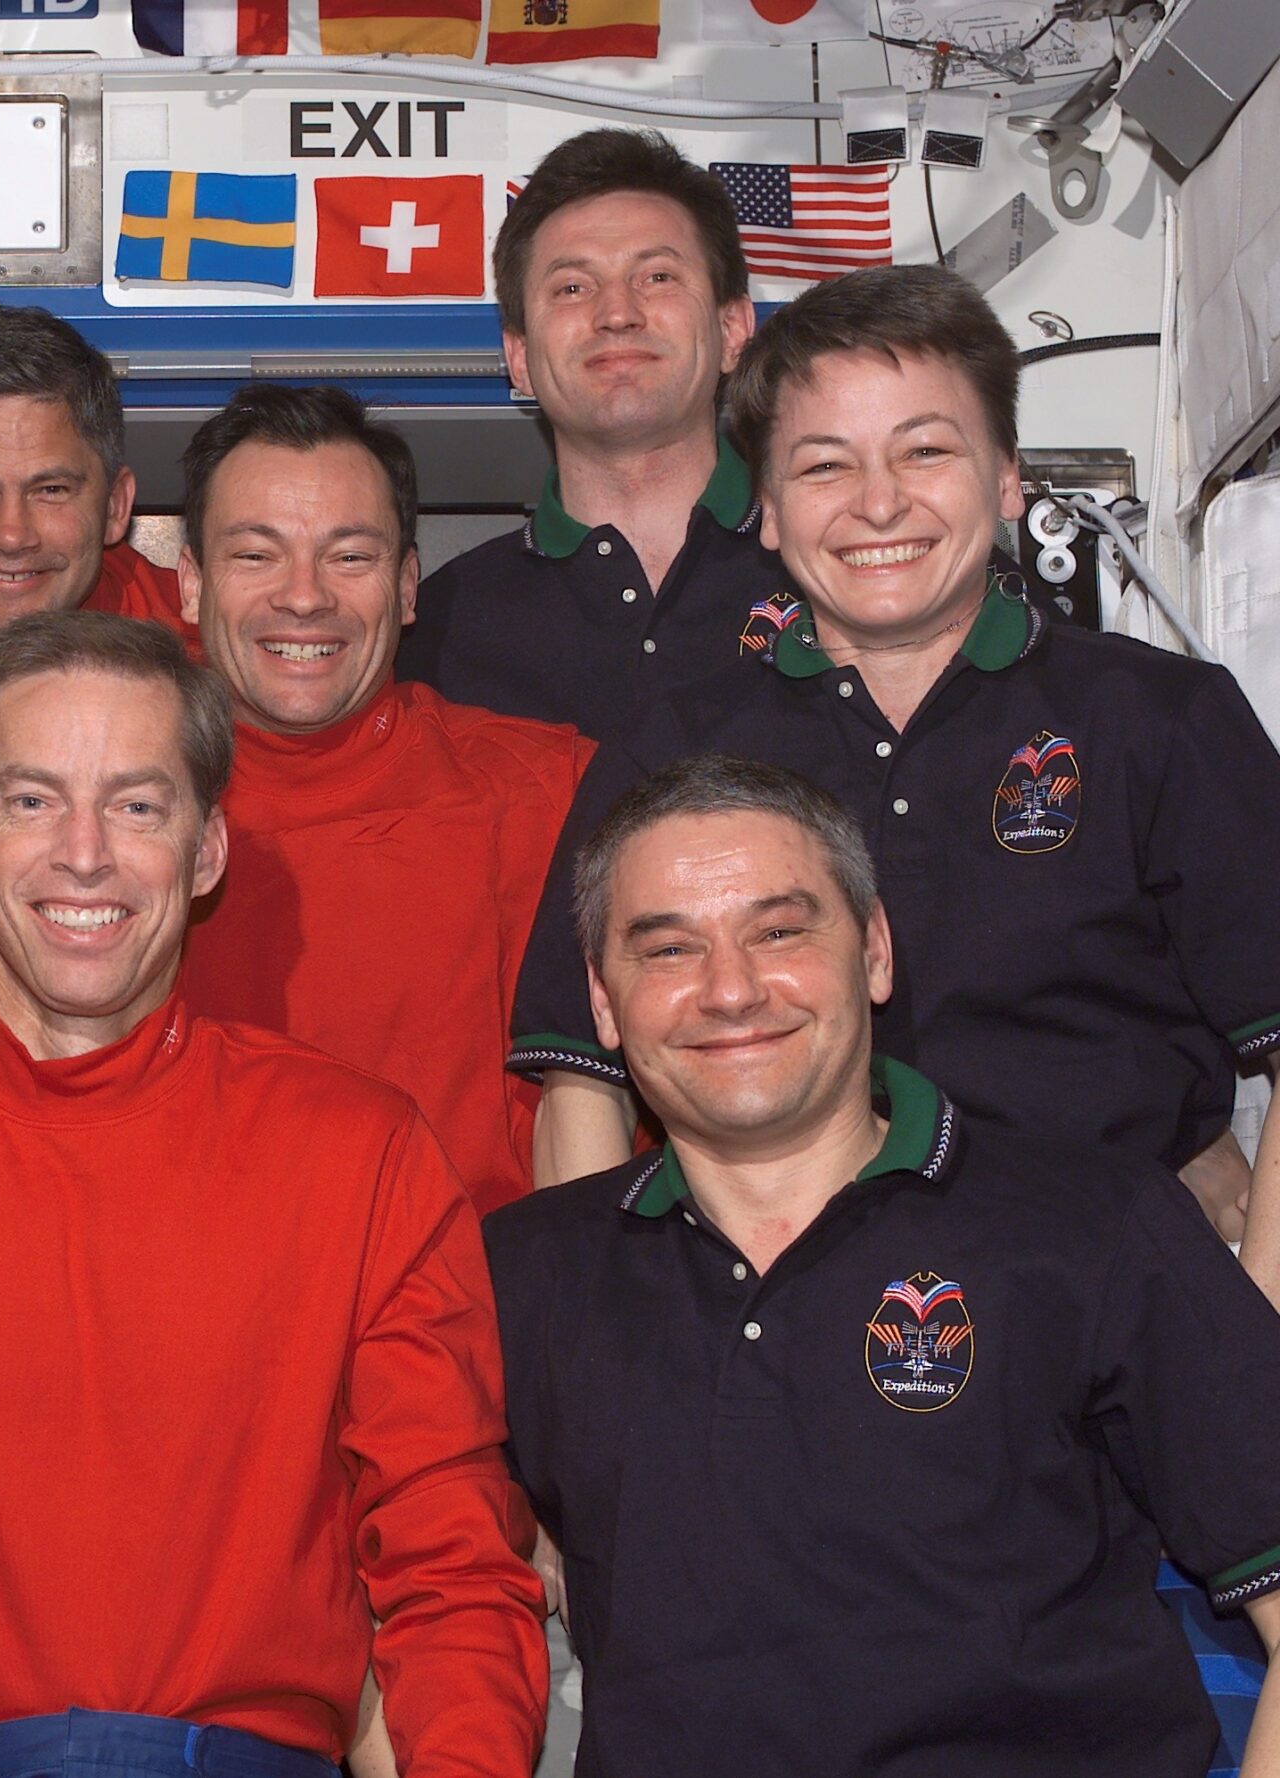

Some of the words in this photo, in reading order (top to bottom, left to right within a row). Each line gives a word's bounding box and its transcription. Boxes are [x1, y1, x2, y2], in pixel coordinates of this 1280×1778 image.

[290, 101, 465, 157] EXIT
[1002, 826, 1057, 841] Expedition
[1058, 828, 1065, 838] 5
[882, 1378, 946, 1393] Expedition
[947, 1383, 955, 1394] 5
